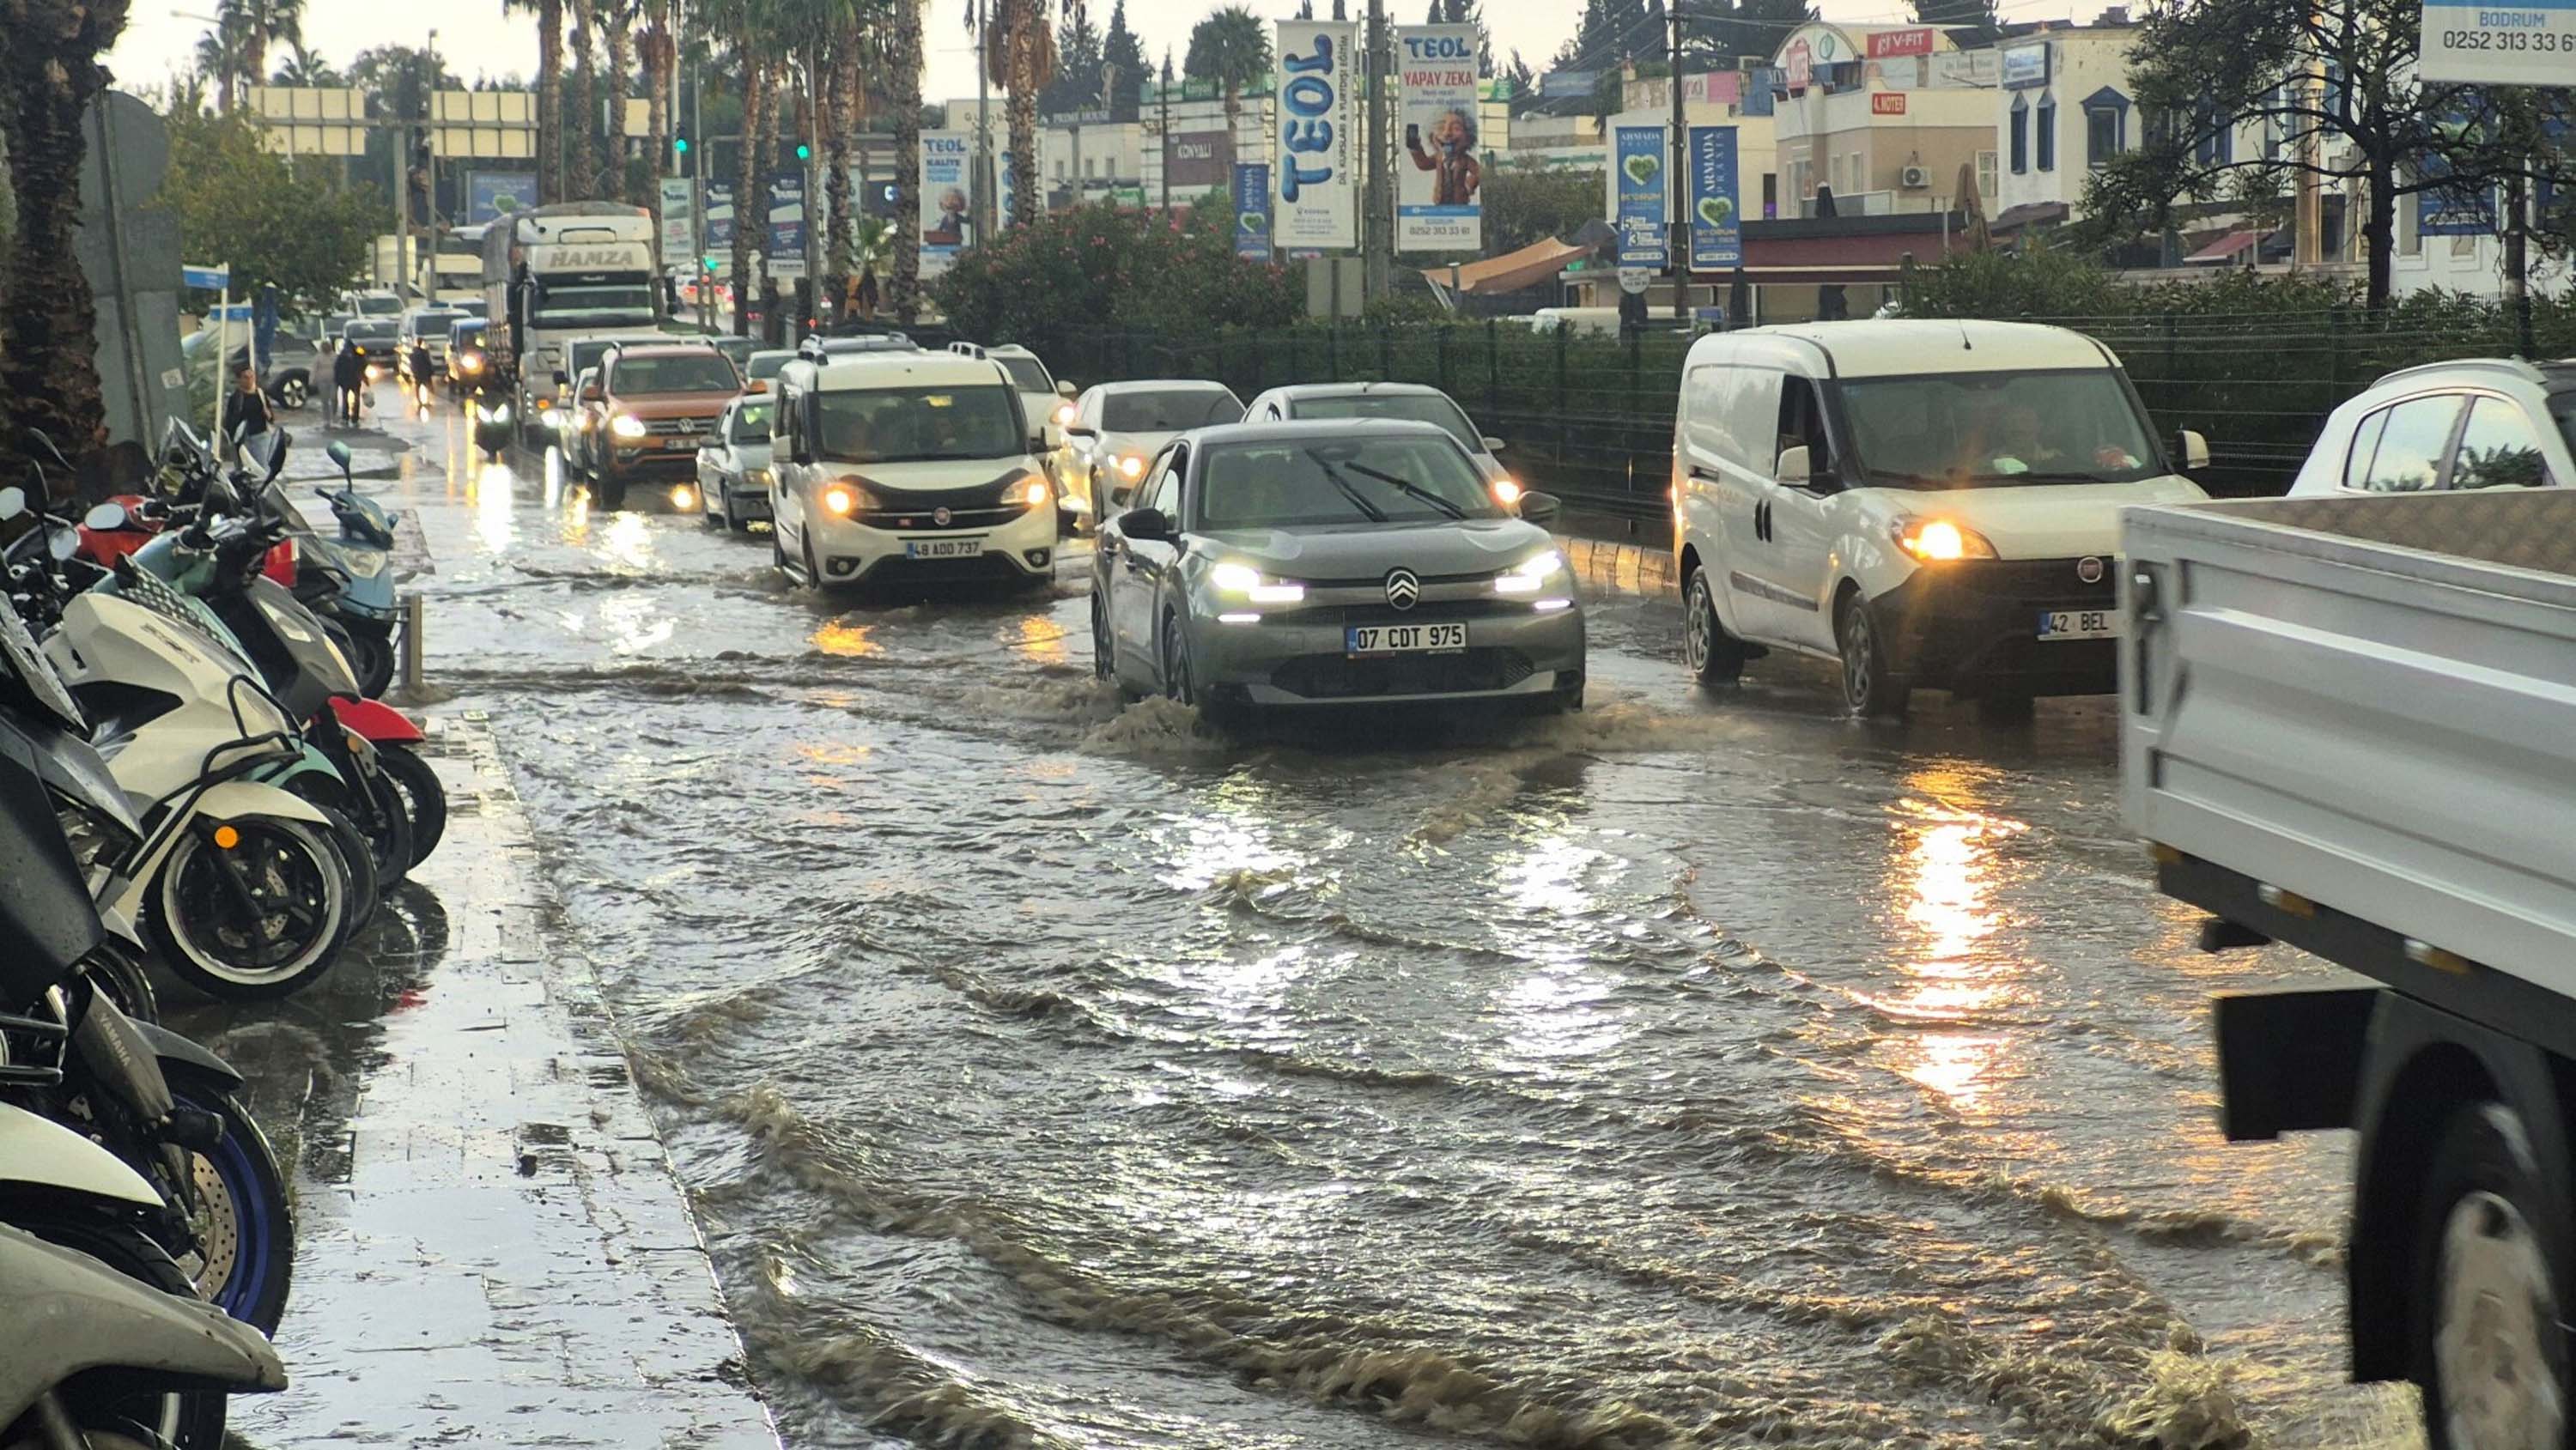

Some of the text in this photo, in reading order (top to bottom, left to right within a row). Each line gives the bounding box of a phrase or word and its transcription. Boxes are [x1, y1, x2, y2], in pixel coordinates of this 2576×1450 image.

[2479, 12, 2546, 27] BODRUM
[1404, 37, 1471, 58] TEOL
[1892, 32, 1924, 47] V-FIT
[2444, 31, 2491, 50] 0252
[2496, 32, 2526, 51] 313
[2532, 33, 2556, 52] 33
[1404, 71, 1473, 86] YAPAY ZEKA
[1881, 95, 1904, 111] NOTER
[1281, 33, 1334, 203] TEOL
[924, 137, 966, 152] TEOL
[1177, 142, 1212, 159] KONYALI
[1704, 132, 1716, 191] ARMADA
[1409, 226, 1431, 235] 0252
[1433, 226, 1447, 235] 313
[1449, 226, 1459, 235] 33
[550, 250, 635, 267] HAMZA
[957, 542, 980, 554] 737
[2050, 612, 2109, 632] 42 BEL
[1358, 626, 1462, 649] 07 CDT 975
[99, 1013, 131, 1067] YAMAHA
